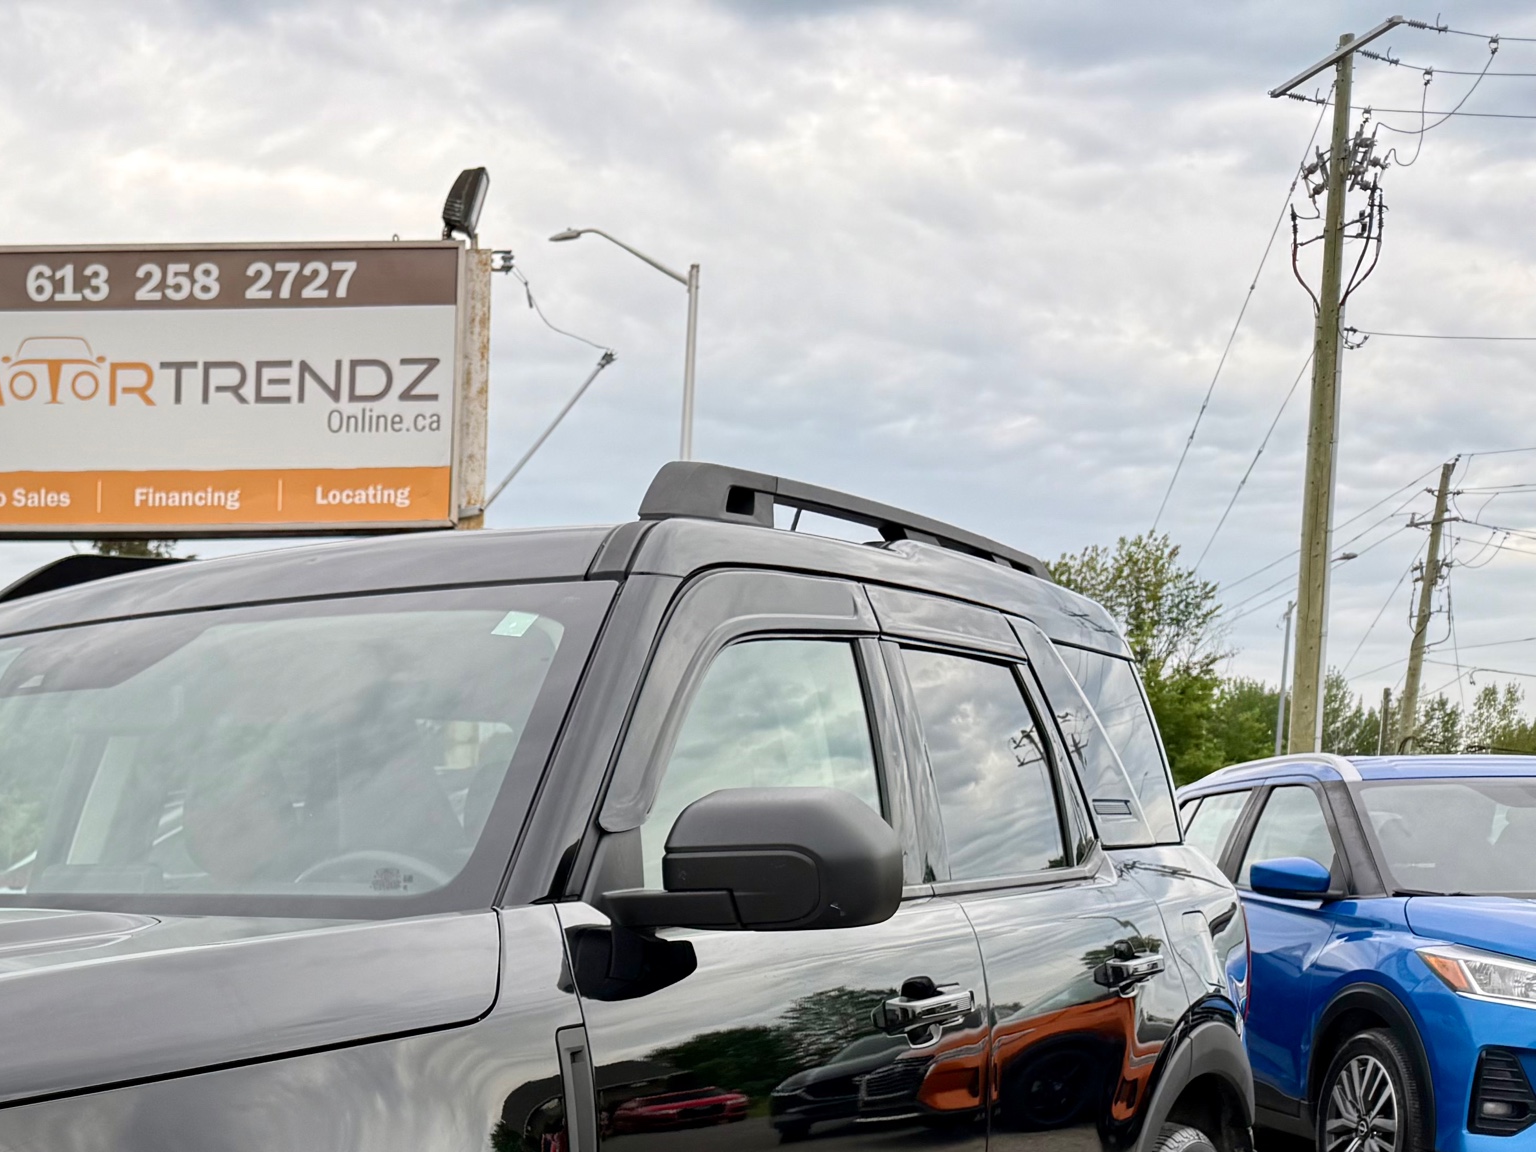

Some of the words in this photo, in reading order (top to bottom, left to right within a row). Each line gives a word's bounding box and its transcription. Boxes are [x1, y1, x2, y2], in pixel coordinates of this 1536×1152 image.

[25, 264, 109, 301] 613
[134, 263, 220, 300] 258
[245, 260, 357, 299] 2727
[327, 409, 441, 434] Online.ca
[13, 487, 70, 508] Sales
[134, 485, 240, 511] Financing
[315, 484, 411, 509] Locating
